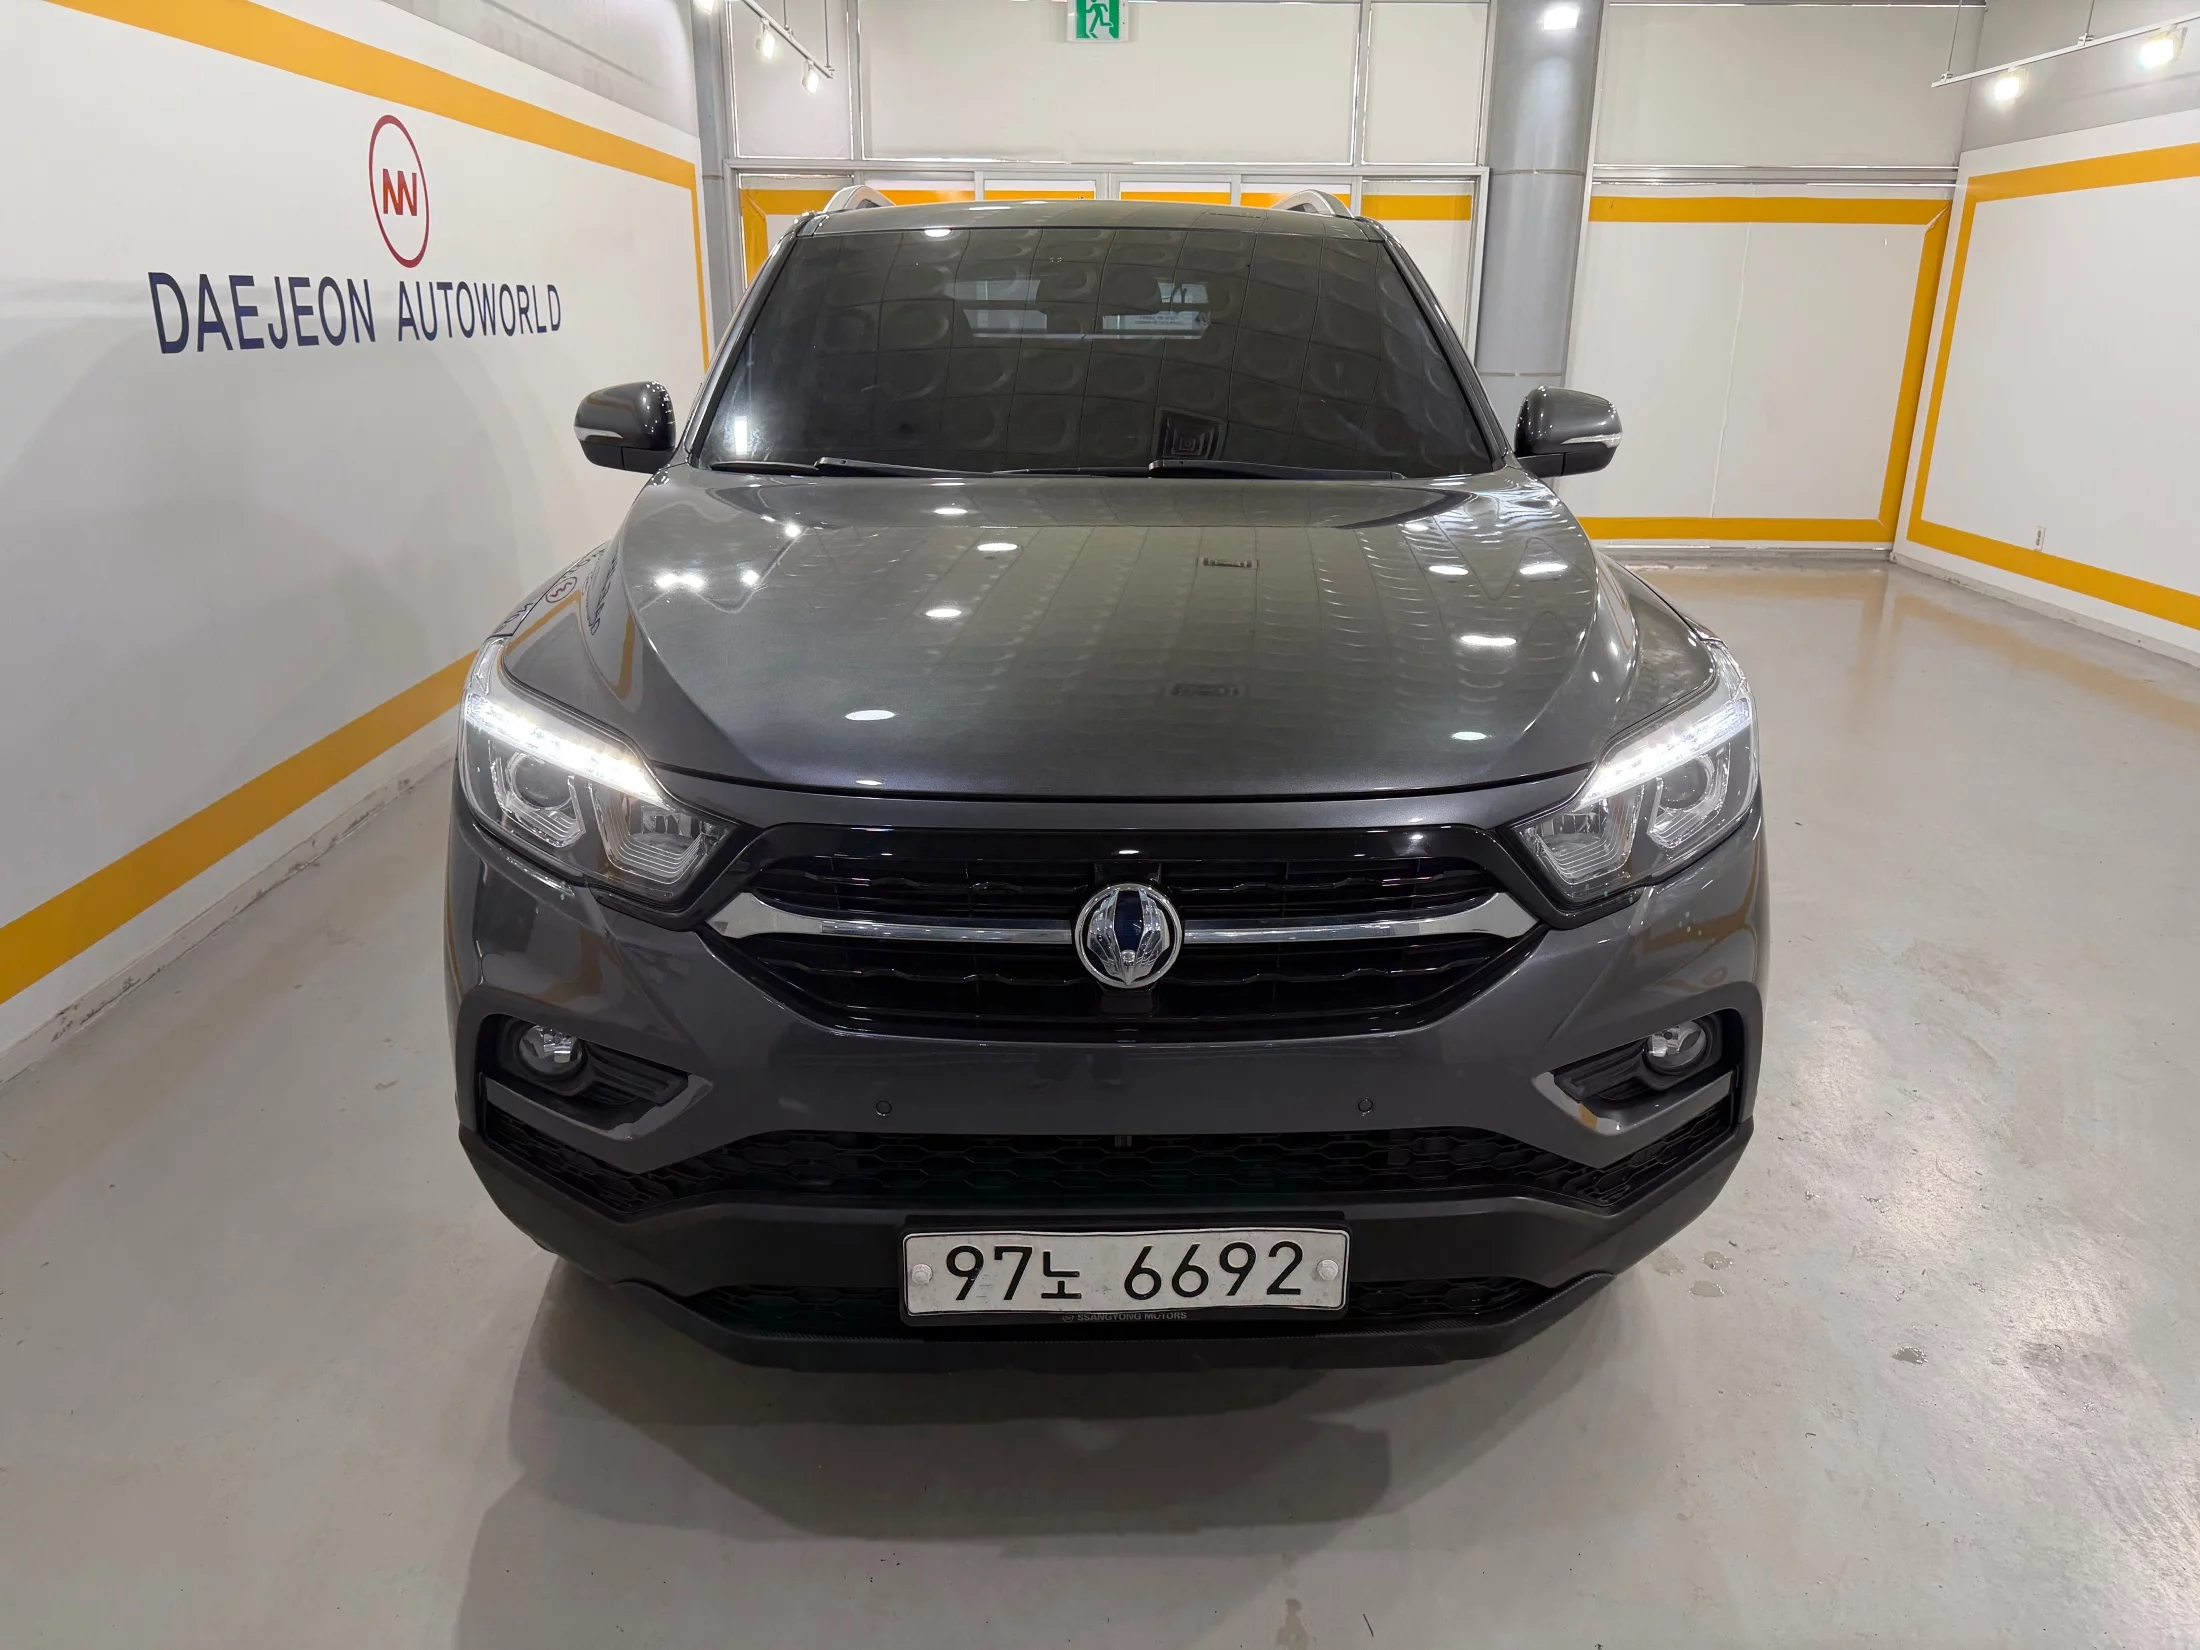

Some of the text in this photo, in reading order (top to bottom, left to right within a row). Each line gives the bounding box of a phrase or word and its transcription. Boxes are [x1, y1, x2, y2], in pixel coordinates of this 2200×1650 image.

[148, 272, 562, 354] DAEJEON AUTOWORLD
[945, 1240, 1304, 1301] 97노 6692
[1077, 1311, 1187, 1322] SSANGYONG MOTORS
